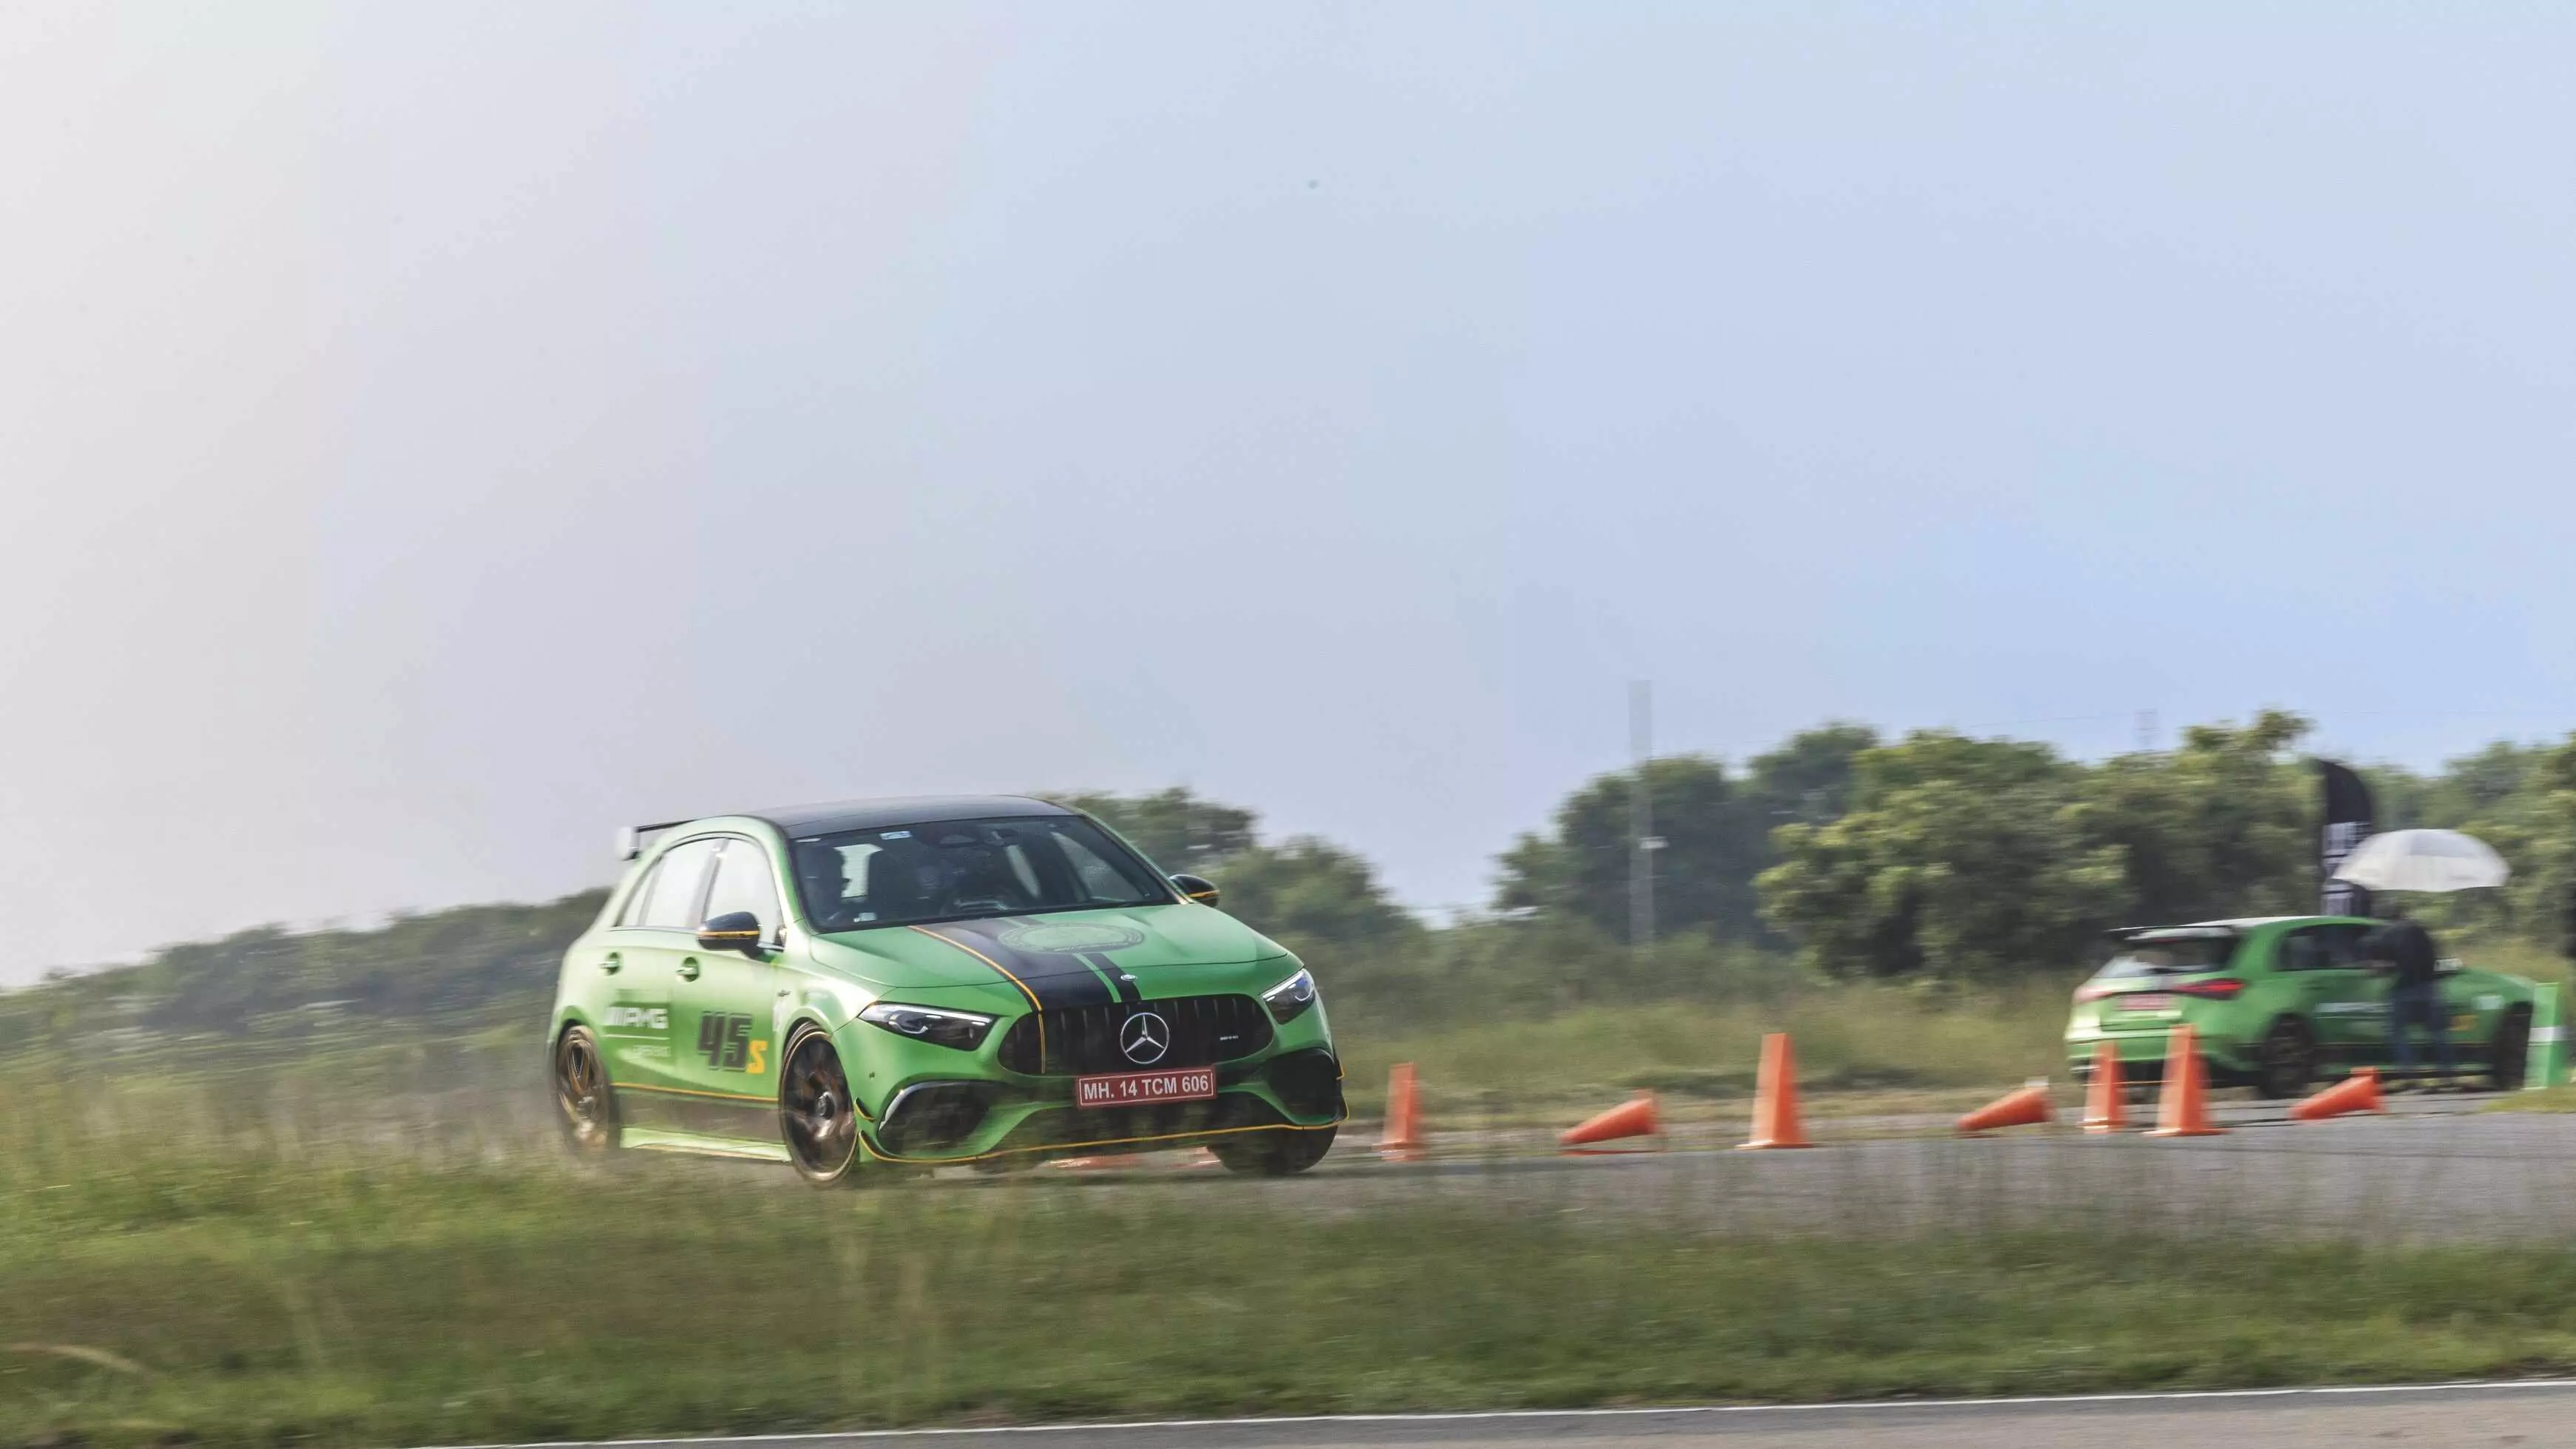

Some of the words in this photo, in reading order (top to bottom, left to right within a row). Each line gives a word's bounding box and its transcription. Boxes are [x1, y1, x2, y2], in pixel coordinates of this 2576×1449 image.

[1084, 1083, 1115, 1100] MH.
[1120, 1080, 1137, 1097] 14
[1141, 1077, 1177, 1095] TCM
[1182, 1075, 1208, 1092] 606
